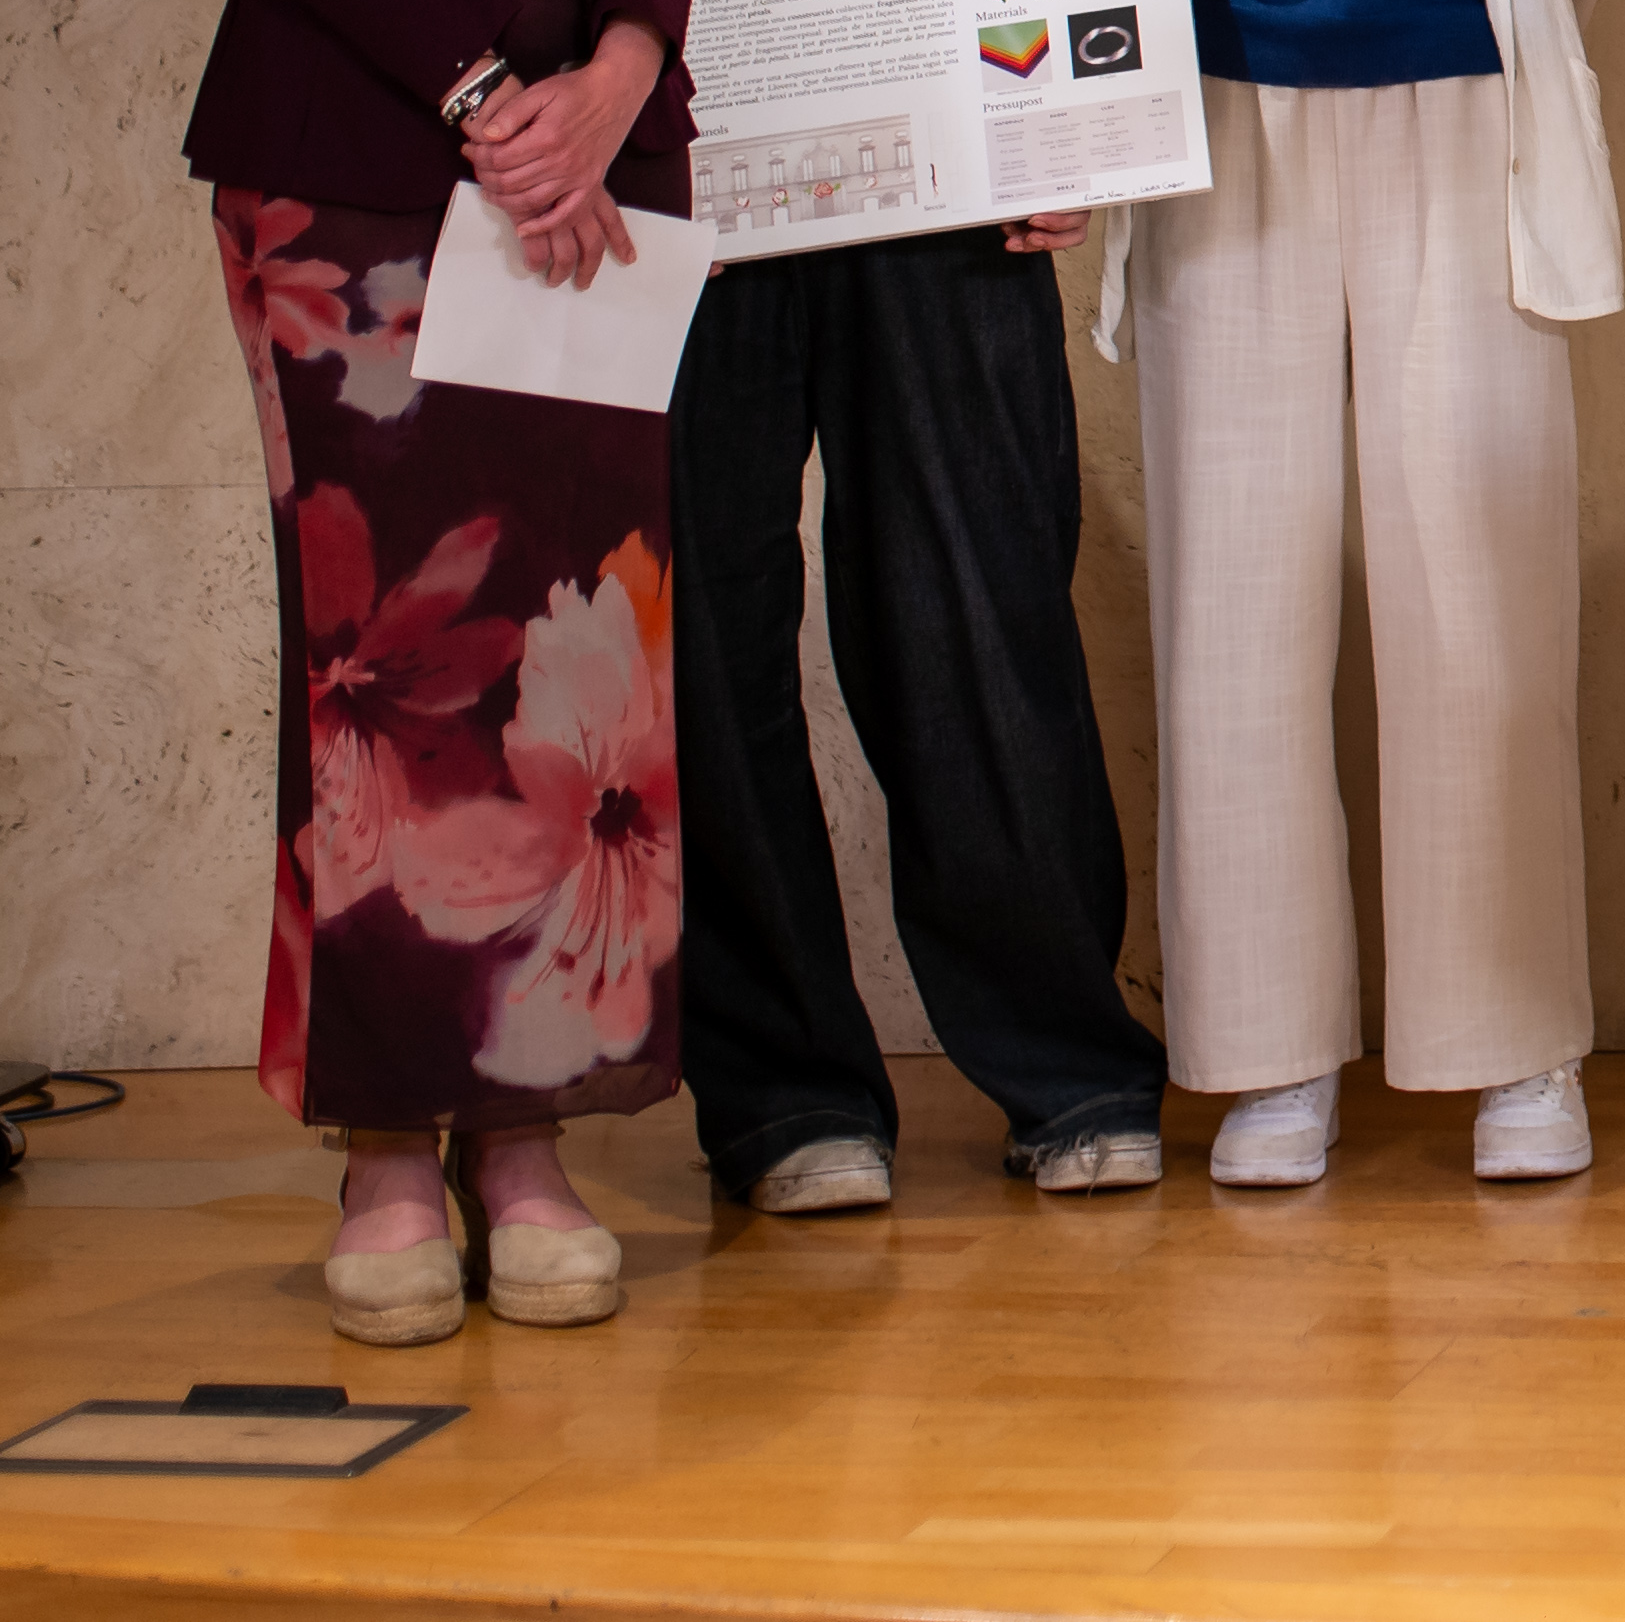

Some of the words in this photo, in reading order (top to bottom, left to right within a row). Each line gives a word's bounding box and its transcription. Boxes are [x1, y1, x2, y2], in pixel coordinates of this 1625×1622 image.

[975, 5, 1028, 23] Materials
[982, 97, 1043, 114] Pressupost
[699, 124, 729, 138] ànols
